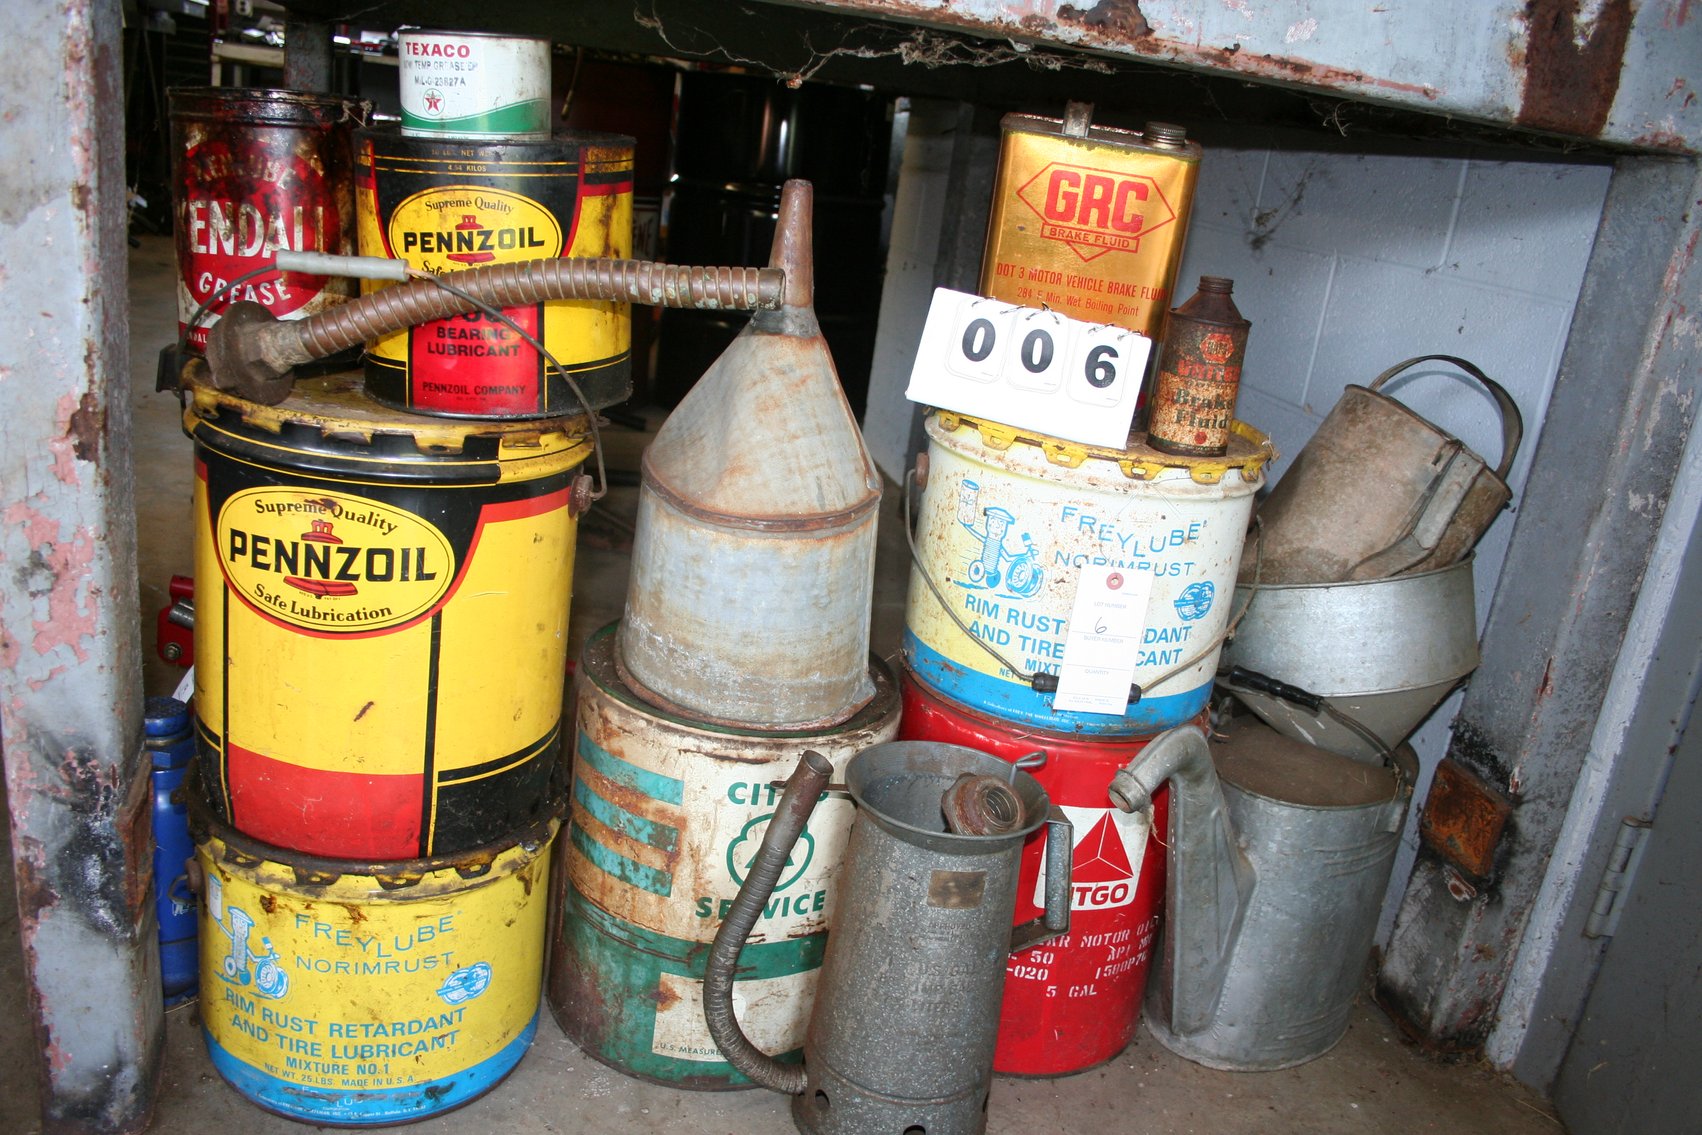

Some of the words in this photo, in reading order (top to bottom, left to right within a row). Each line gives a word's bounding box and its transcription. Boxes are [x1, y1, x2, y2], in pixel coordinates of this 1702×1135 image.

[405, 42, 471, 58] TEXACO
[414, 60, 432, 69] TEMP
[460, 149, 475, 157] NET
[466, 164, 487, 172] KILOS
[424, 196, 473, 213] Supreme
[474, 196, 514, 215] Quality
[1044, 169, 1149, 234] GRC
[178, 199, 325, 259] ENDALL
[403, 226, 545, 253] PENNZOIL
[1049, 227, 1091, 242] BRAKE
[1094, 235, 1130, 249] FLUID
[199, 271, 292, 306] GREASE
[997, 262, 1016, 278] DOT
[1018, 266, 1025, 279] 3
[1028, 268, 1062, 286] MOTOR
[1066, 274, 1104, 293] VEHICLE
[1107, 281, 1138, 298] BRAKE
[1140, 286, 1168, 302] FLUID
[1046, 291, 1062, 304] Min.
[1066, 294, 1082, 308] Wet
[1085, 297, 1114, 314] Boiling
[1117, 303, 1140, 317] Point
[437, 326, 512, 341] BEARING
[427, 341, 521, 357] LUBRICANT
[422, 381, 470, 395] PENNZOIL
[474, 385, 526, 396] COMPANY
[1173, 388, 1233, 410] Brake
[1174, 408, 1229, 429] Fluid
[254, 499, 327, 517] Supreme
[330, 504, 398, 536] Quality
[1060, 505, 1202, 558] FREYLUBE
[229, 527, 438, 583] PENNZOIL
[253, 583, 287, 611] Safe
[289, 600, 393, 622] Lubrication
[964, 592, 1000, 620] RIM
[1006, 607, 1067, 636] RUST
[1094, 616, 1107, 634] 6
[968, 619, 1011, 647] AND
[1018, 634, 1066, 660] TIRE
[999, 667, 1016, 678] NET
[727, 781, 829, 806] CIT
[695, 889, 827, 920] SEVICE
[1070, 883, 1129, 906] TGO
[295, 913, 455, 959] FREYLUBE
[1080, 929, 1131, 948] MOTOR
[296, 951, 455, 975] NORIMRUST
[1031, 950, 1055, 965] 50
[1046, 985, 1057, 998] 5
[1068, 984, 1098, 998] GAL
[225, 986, 256, 1016] RIM
[261, 1007, 318, 1036] RUST
[328, 1007, 468, 1039] RETARDANT
[231, 1014, 269, 1043] AND
[275, 1033, 323, 1058] TIRE
[331, 1029, 461, 1060] LUBRICANT
[678, 1045, 722, 1056] MEASURE
[264, 1062, 279, 1074] NET
[301, 1074, 313, 1083] 25
[341, 1078, 369, 1087] MADE
[373, 1077, 383, 1087] IN
[285, 1055, 350, 1075] MIXTURE
